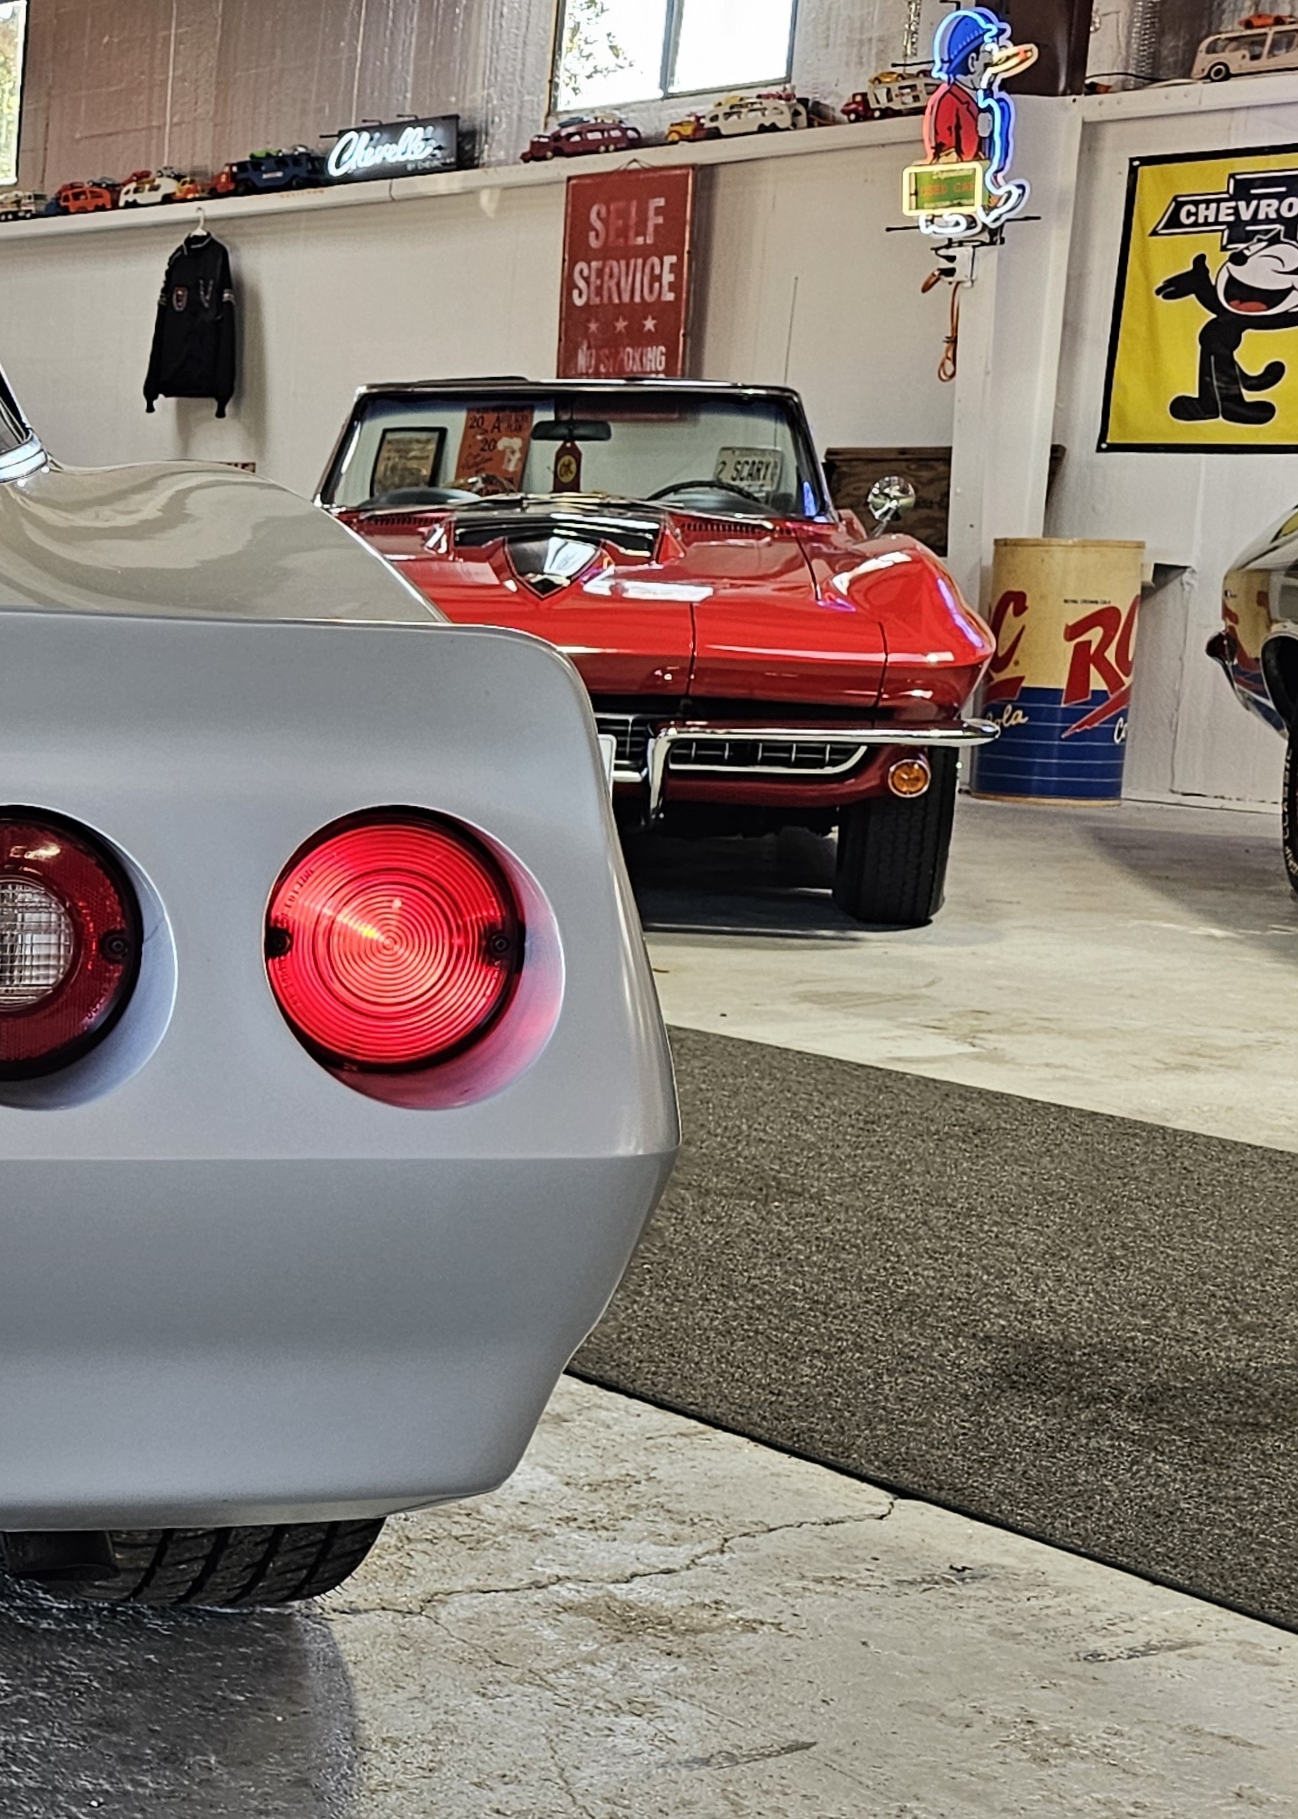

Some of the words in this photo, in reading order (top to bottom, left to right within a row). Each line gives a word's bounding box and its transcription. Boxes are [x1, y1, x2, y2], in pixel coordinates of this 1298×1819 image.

[327, 126, 435, 177] Chevelle
[588, 197, 666, 248] SELF
[1179, 196, 1298, 224] CHEVRO
[572, 254, 678, 306] SERVICE
[576, 342, 596, 374] NO
[731, 460, 772, 481] SCARY
